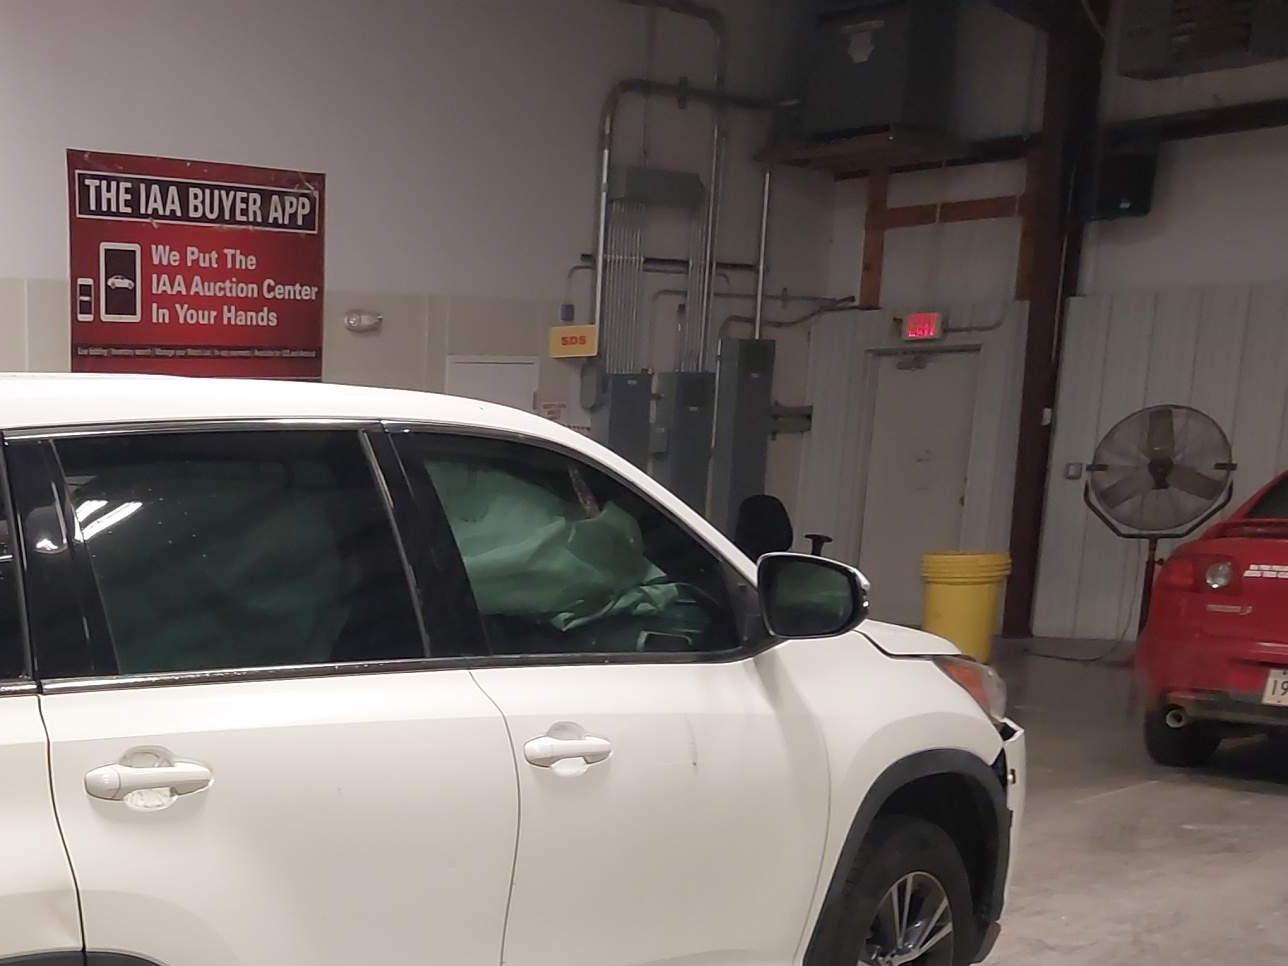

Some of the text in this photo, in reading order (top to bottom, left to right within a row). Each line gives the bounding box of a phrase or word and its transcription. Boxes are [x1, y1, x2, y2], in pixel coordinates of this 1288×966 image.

[84, 179, 311, 226] THE IAA BUYER APP
[151, 244, 257, 270] We Put The
[151, 274, 318, 300] IAA Auction Center
[151, 303, 278, 327] In Your Hands
[561, 336, 587, 346] SDS
